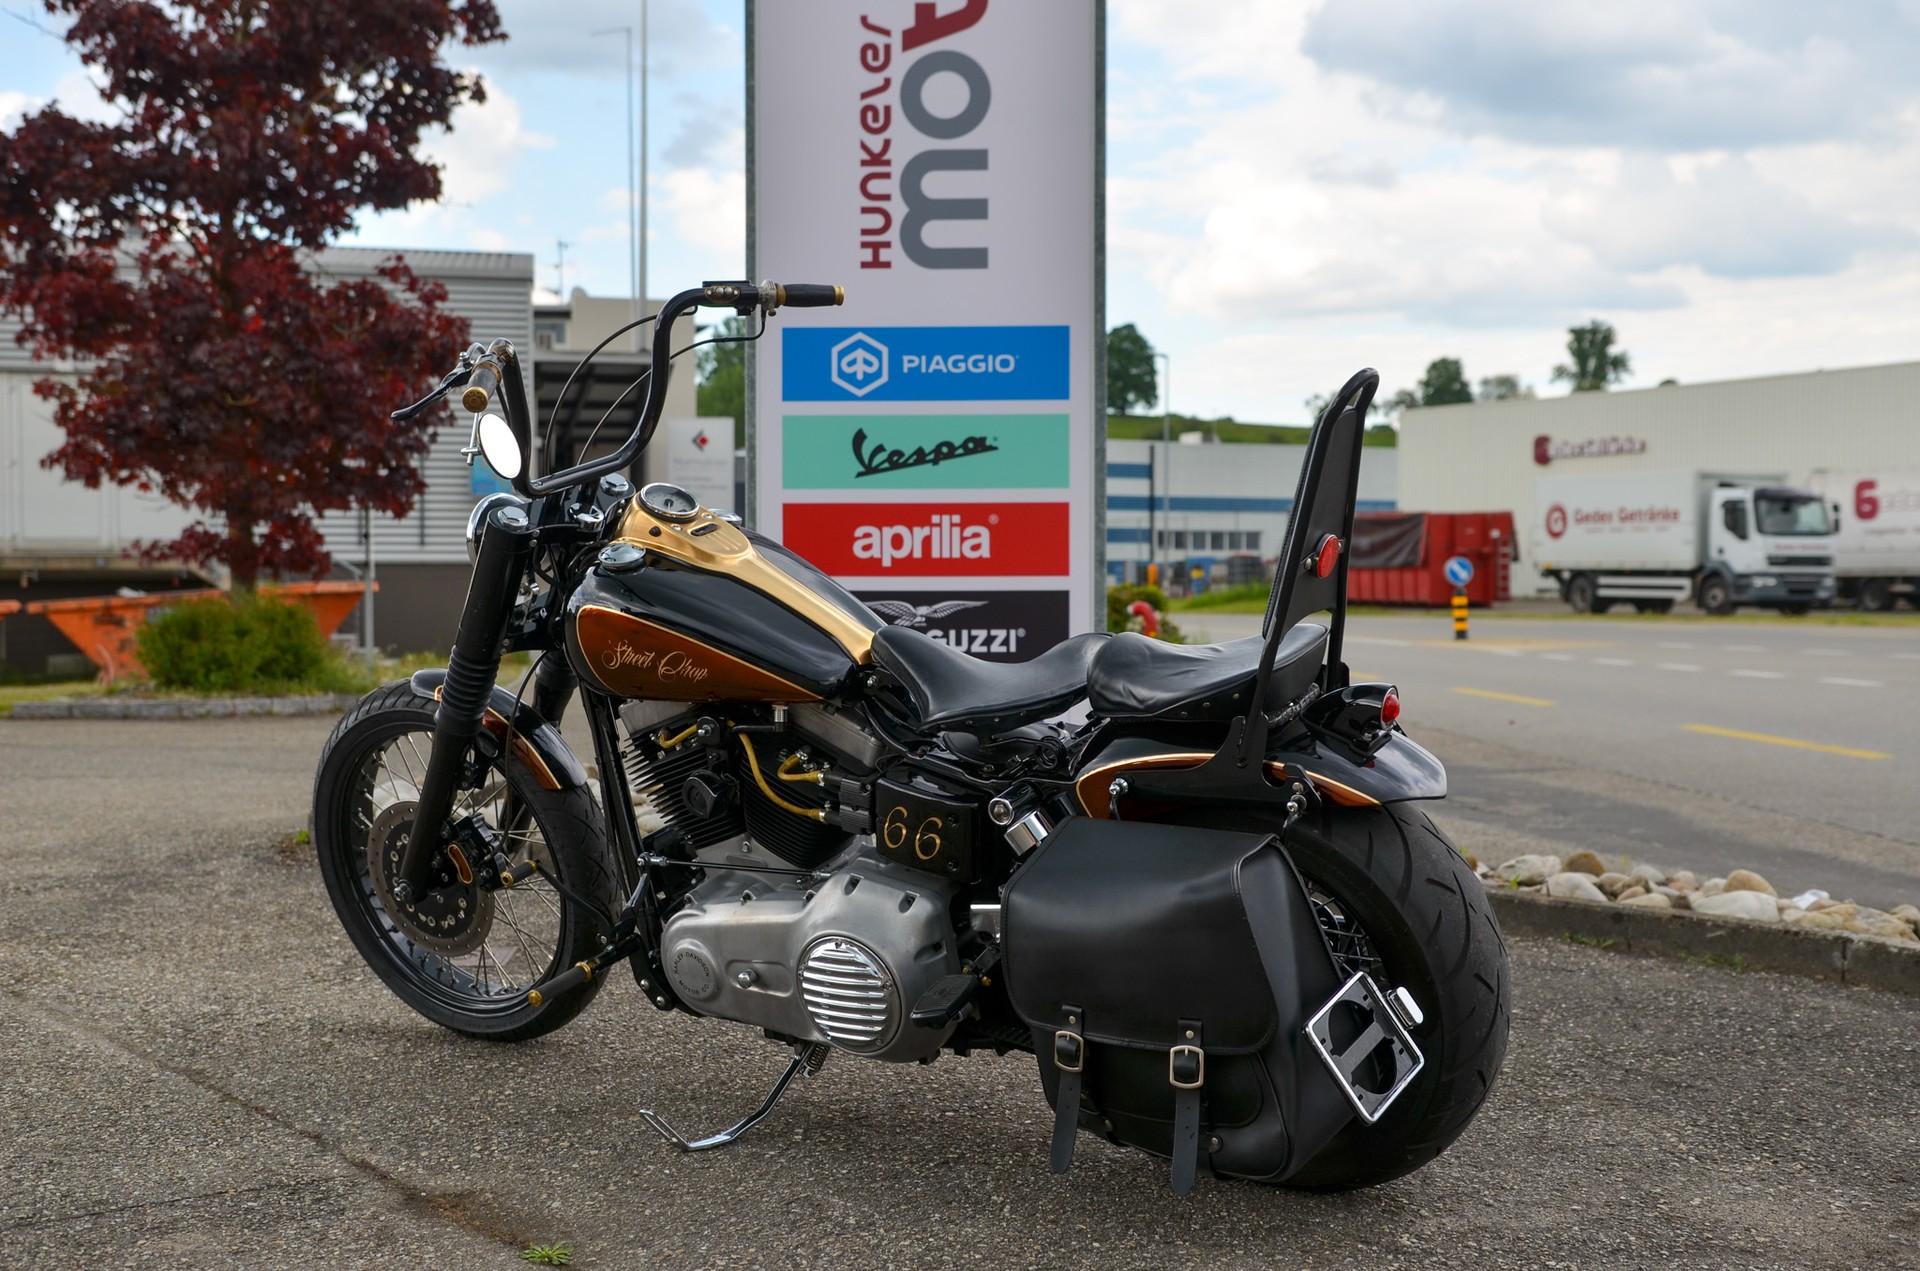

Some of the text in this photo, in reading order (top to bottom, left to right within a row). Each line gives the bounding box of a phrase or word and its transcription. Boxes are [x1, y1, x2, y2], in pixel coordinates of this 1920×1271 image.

[902, 354, 1015, 373] PIAGGIO
[852, 427, 999, 478] Vespa
[852, 514, 991, 567] aprilia
[601, 639, 656, 670] Street
[884, 806, 943, 860] 66
[673, 952, 710, 977] HARLEY-DAVIDSON
[679, 980, 700, 995] MOTOR
